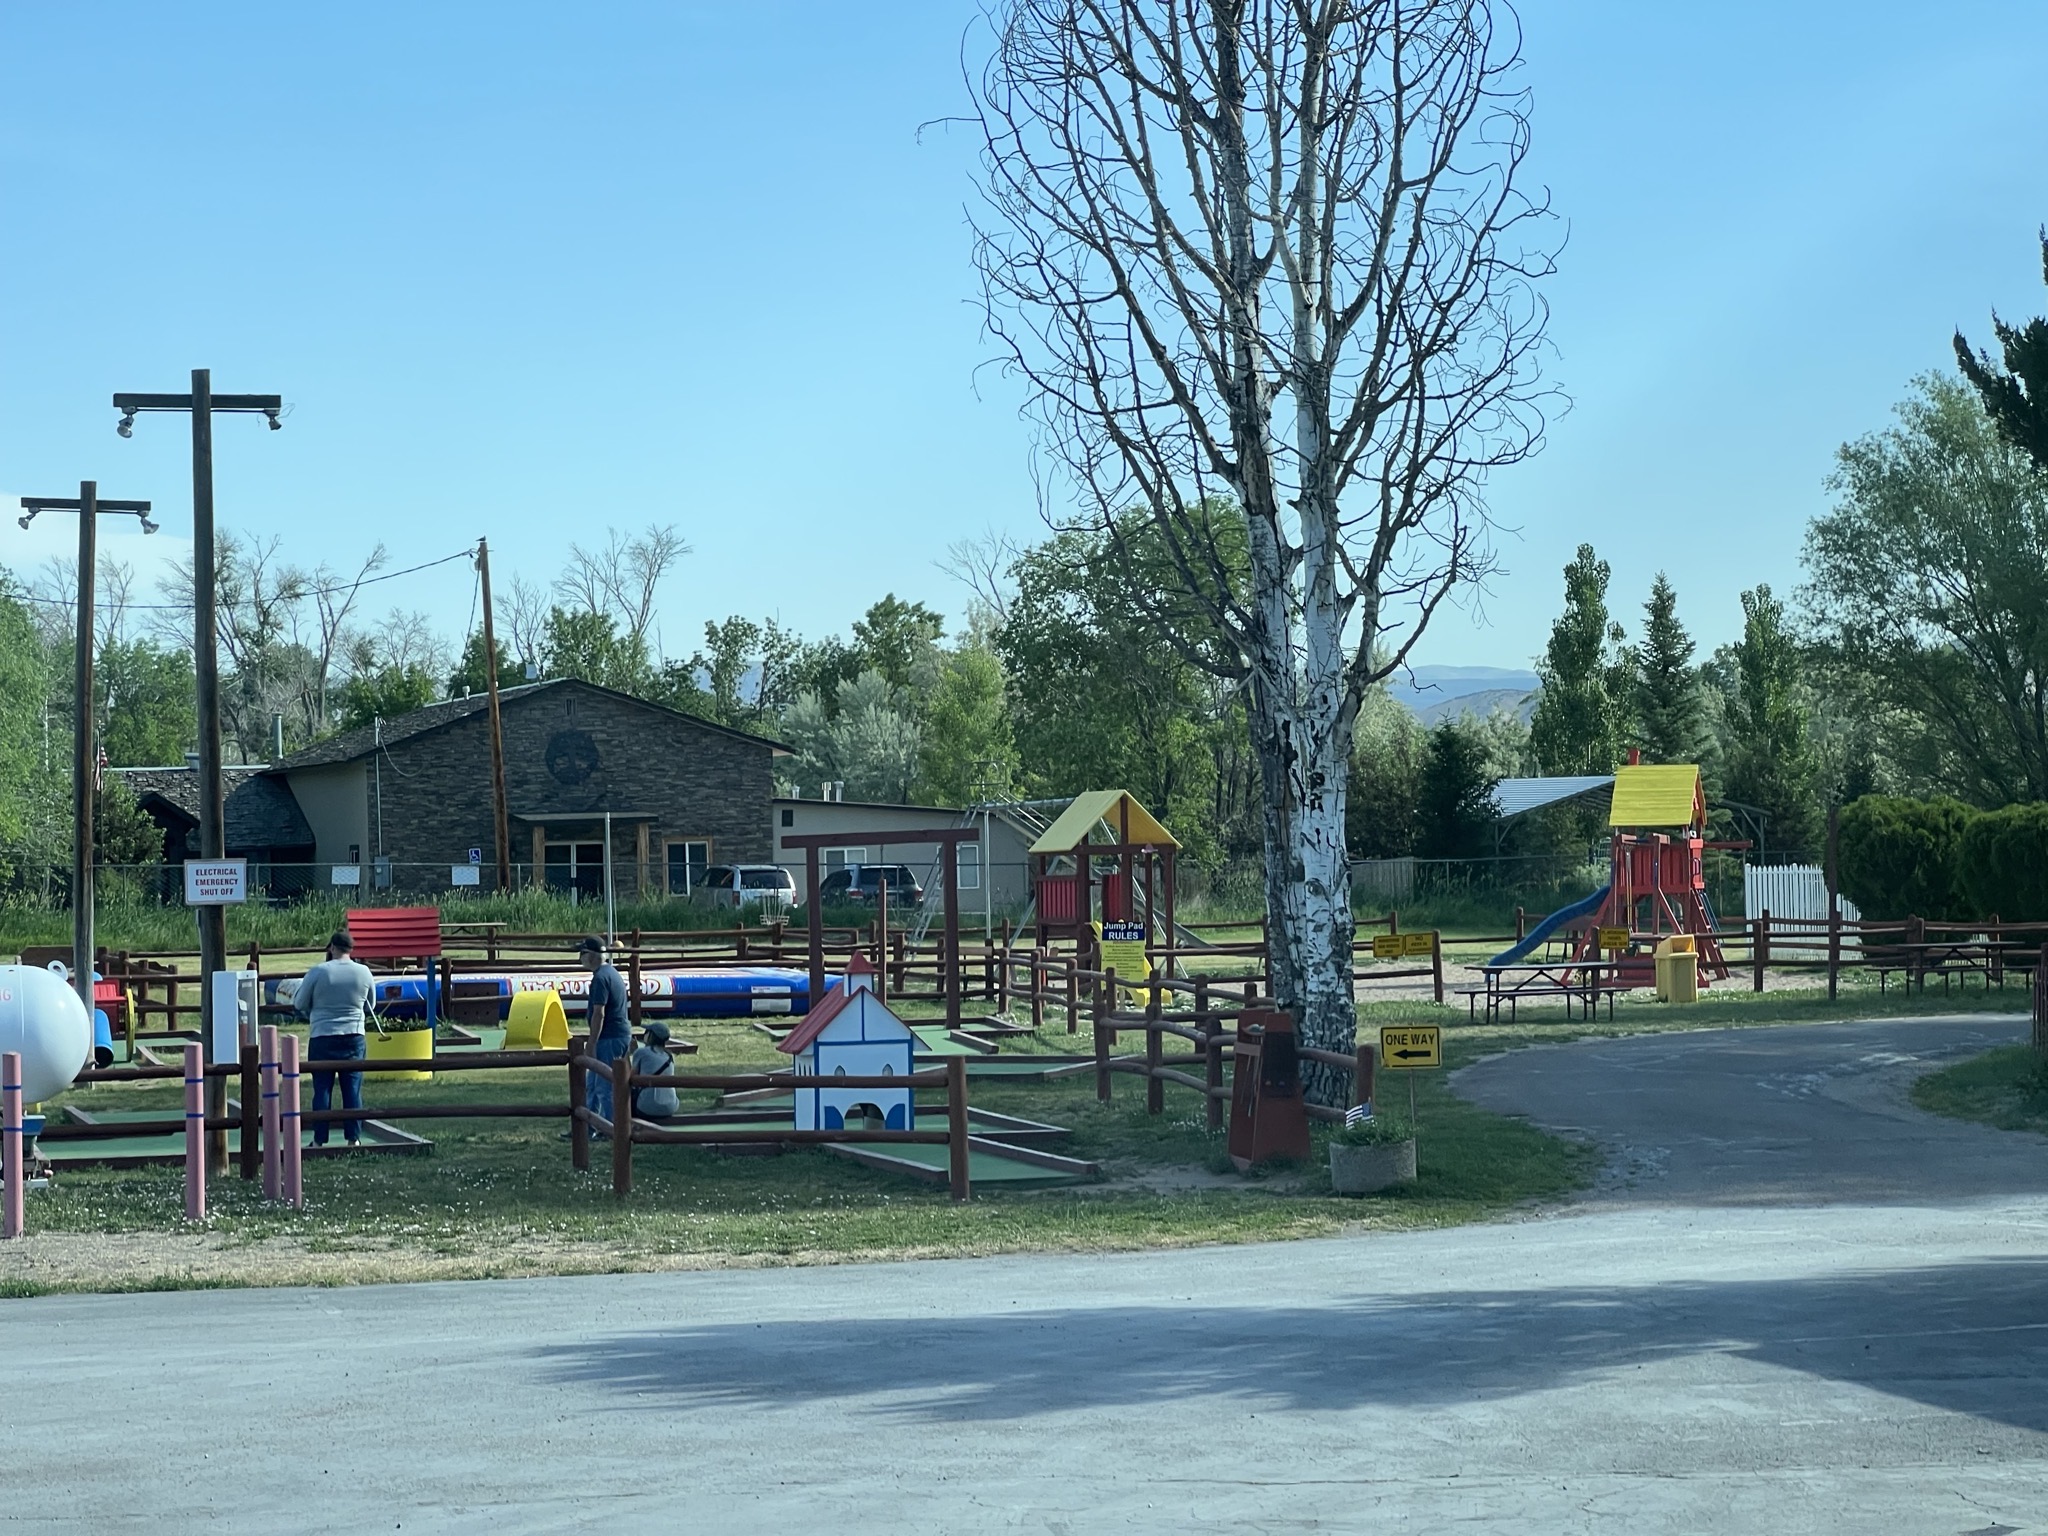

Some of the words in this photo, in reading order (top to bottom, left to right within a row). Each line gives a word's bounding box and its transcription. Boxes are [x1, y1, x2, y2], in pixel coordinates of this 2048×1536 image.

[195, 868, 238, 876] ELECTRICAL
[195, 878, 239, 886] EMERGENCY
[200, 888, 218, 896] SHUT
[220, 888, 234, 896] OFF
[1103, 921, 1127, 931] Jump
[1128, 921, 1144, 930] Pad
[1108, 931, 1139, 940] RULES
[1385, 1033, 1409, 1046] ONE
[1410, 1033, 1435, 1045] WAY
